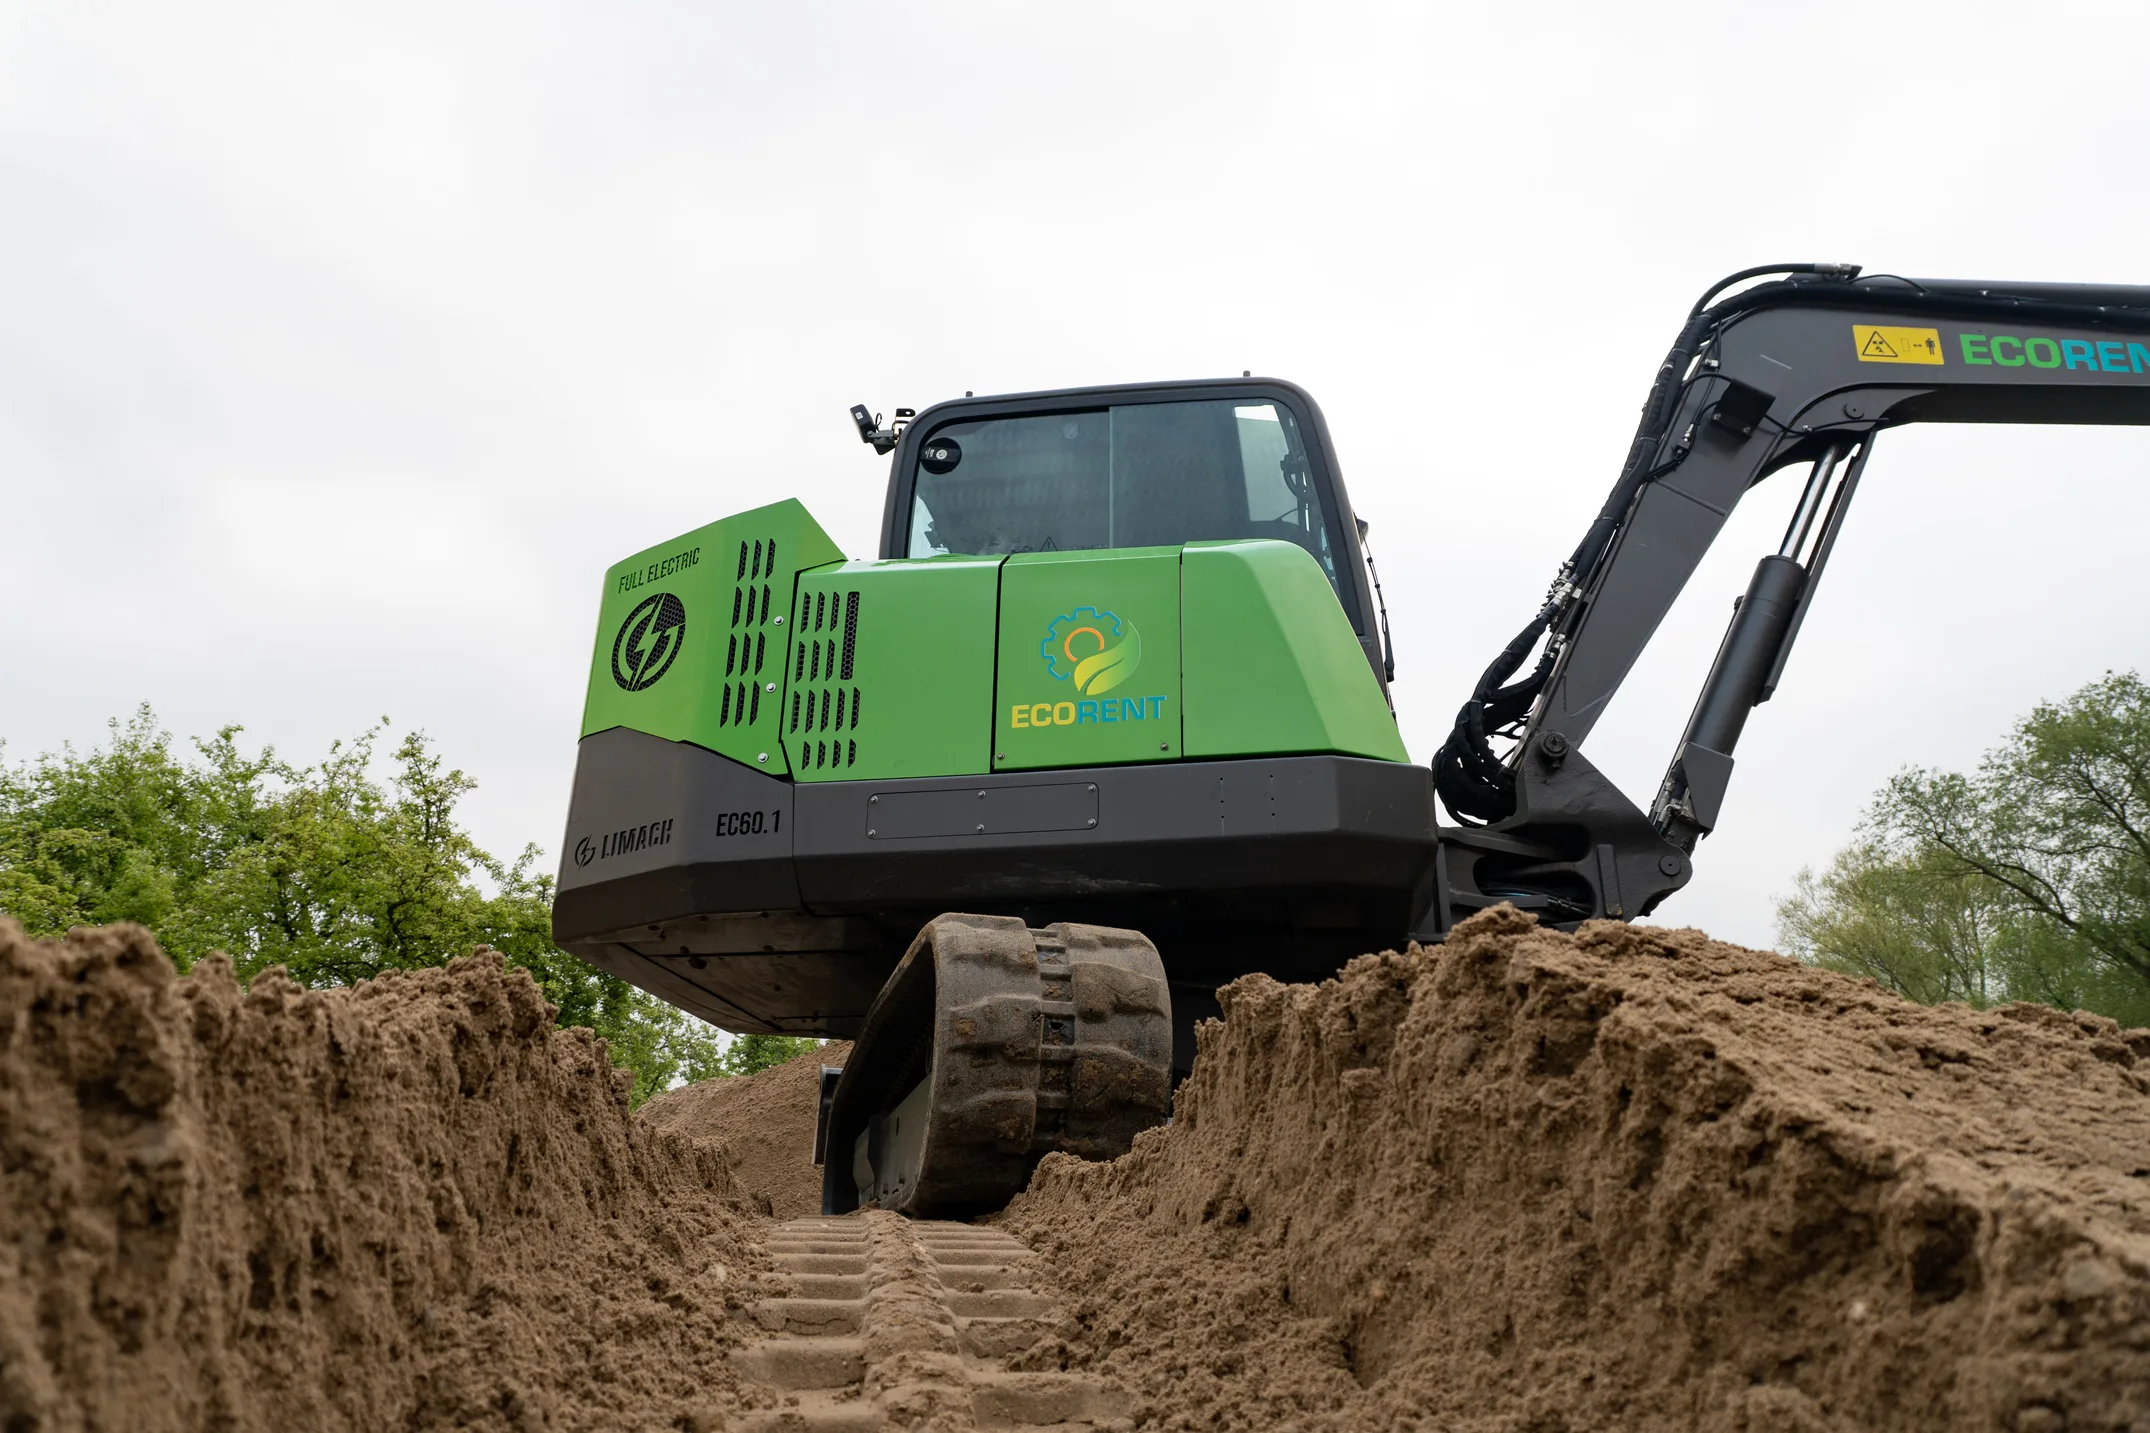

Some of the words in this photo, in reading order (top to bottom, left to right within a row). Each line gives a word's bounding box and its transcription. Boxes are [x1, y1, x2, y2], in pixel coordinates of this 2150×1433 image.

[618, 569, 644, 594] FULL
[647, 547, 700, 583] ELECTRIC
[1011, 695, 1167, 728] ECORENT
[600, 818, 674, 860] LIMACH
[716, 809, 781, 837] EC60.1
